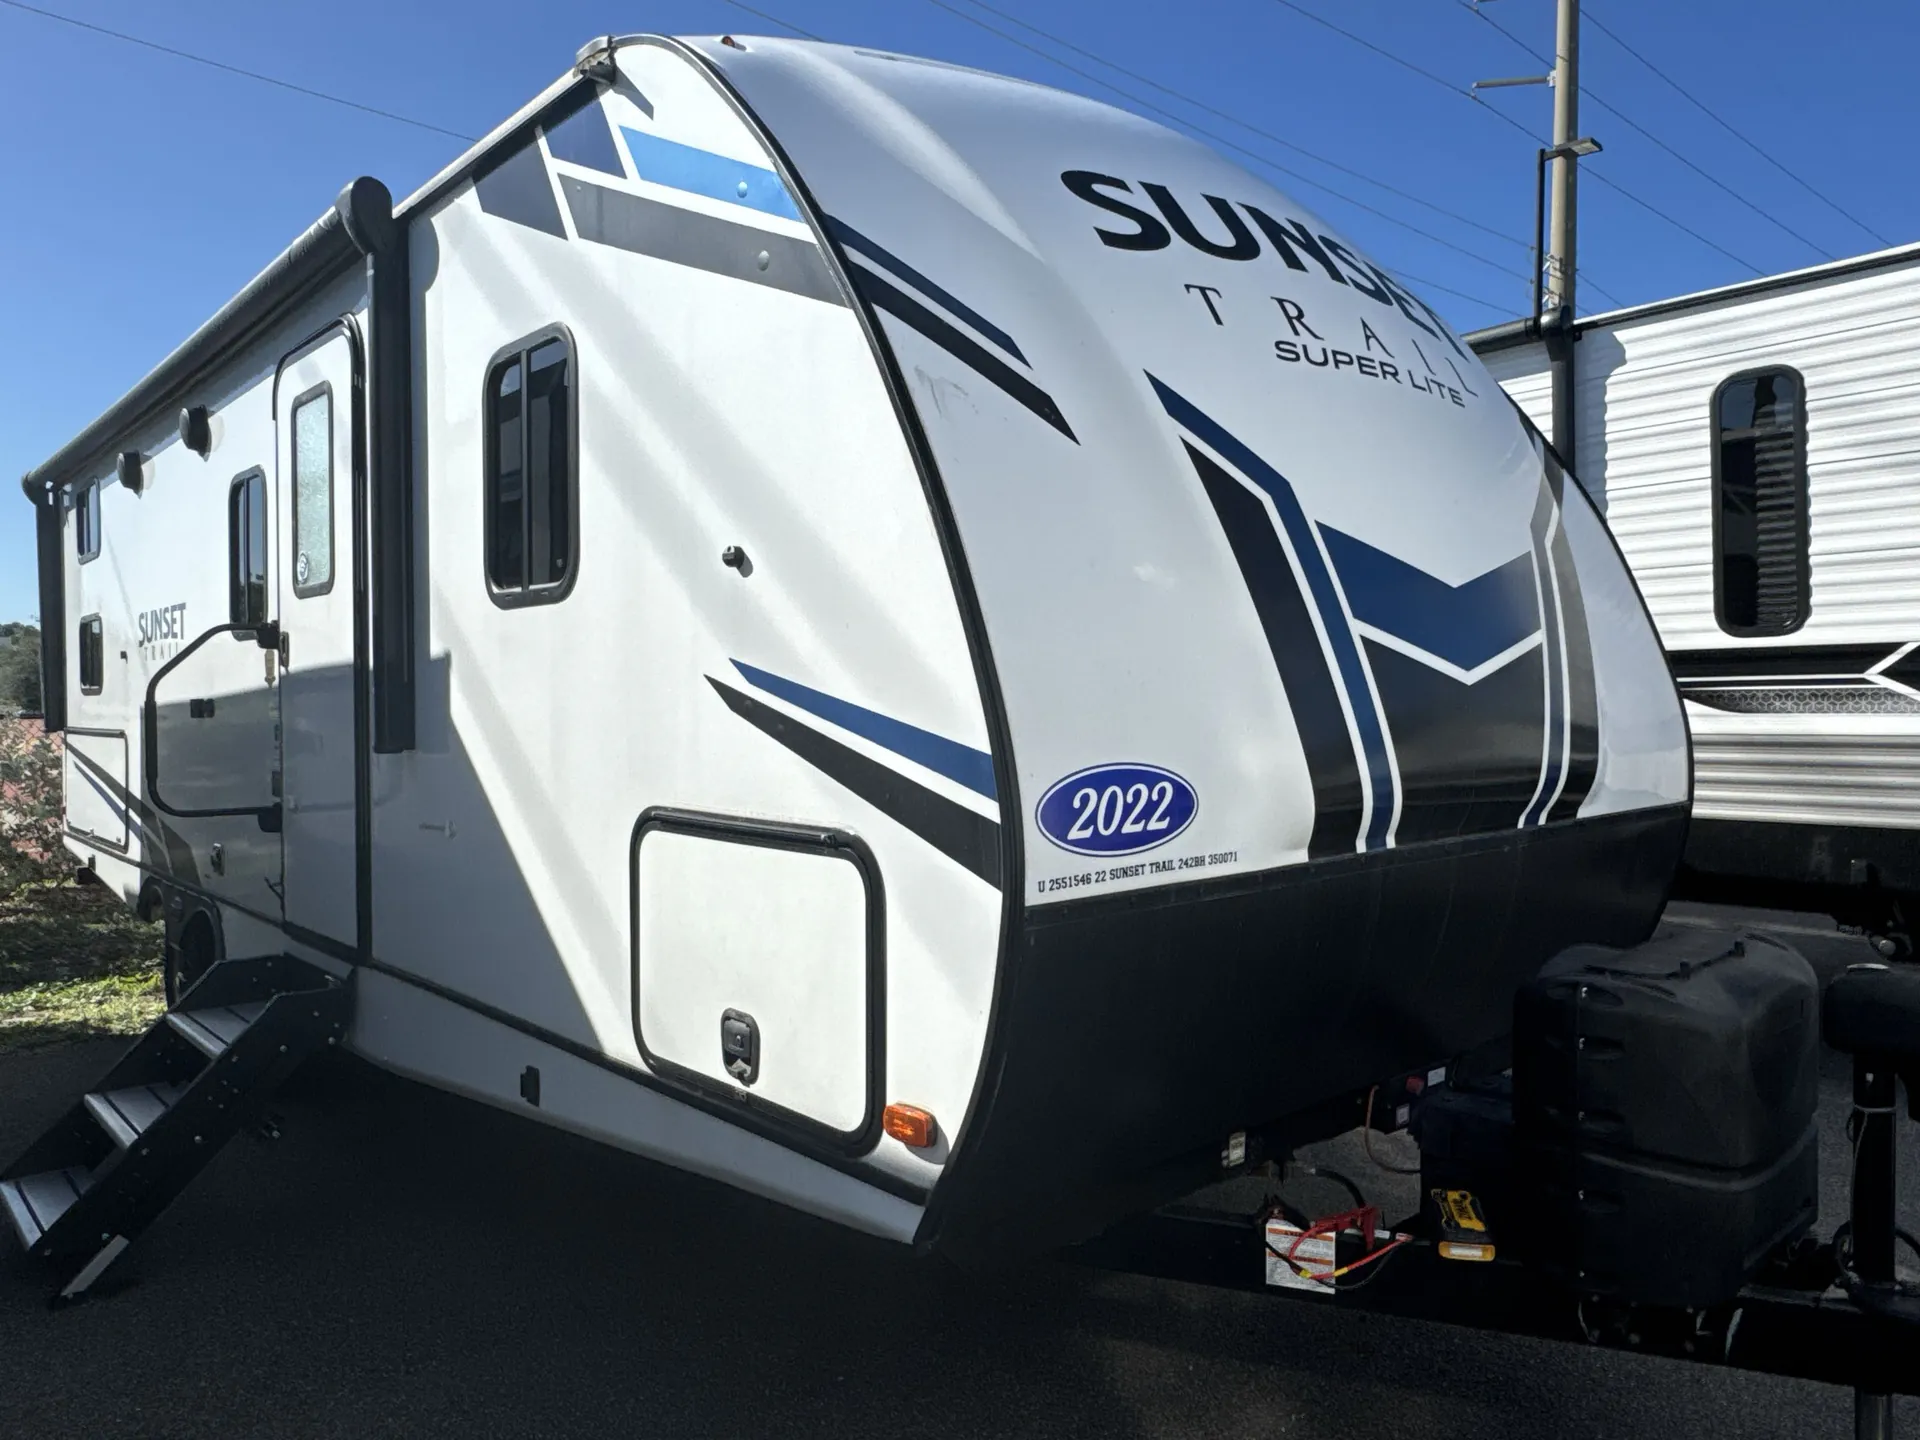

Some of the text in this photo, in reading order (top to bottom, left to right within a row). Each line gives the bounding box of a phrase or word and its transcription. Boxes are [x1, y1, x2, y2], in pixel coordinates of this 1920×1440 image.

[1061, 170, 1470, 363] SUNSET
[1184, 284, 1478, 397] TRAIL
[1275, 341, 1466, 408] SUPER LITE
[138, 602, 187, 648] SUNSET
[1067, 781, 1173, 840] 2022
[1038, 851, 1238, 893] U 2551546 22 SUNSET TRAIL 242BH 350071
